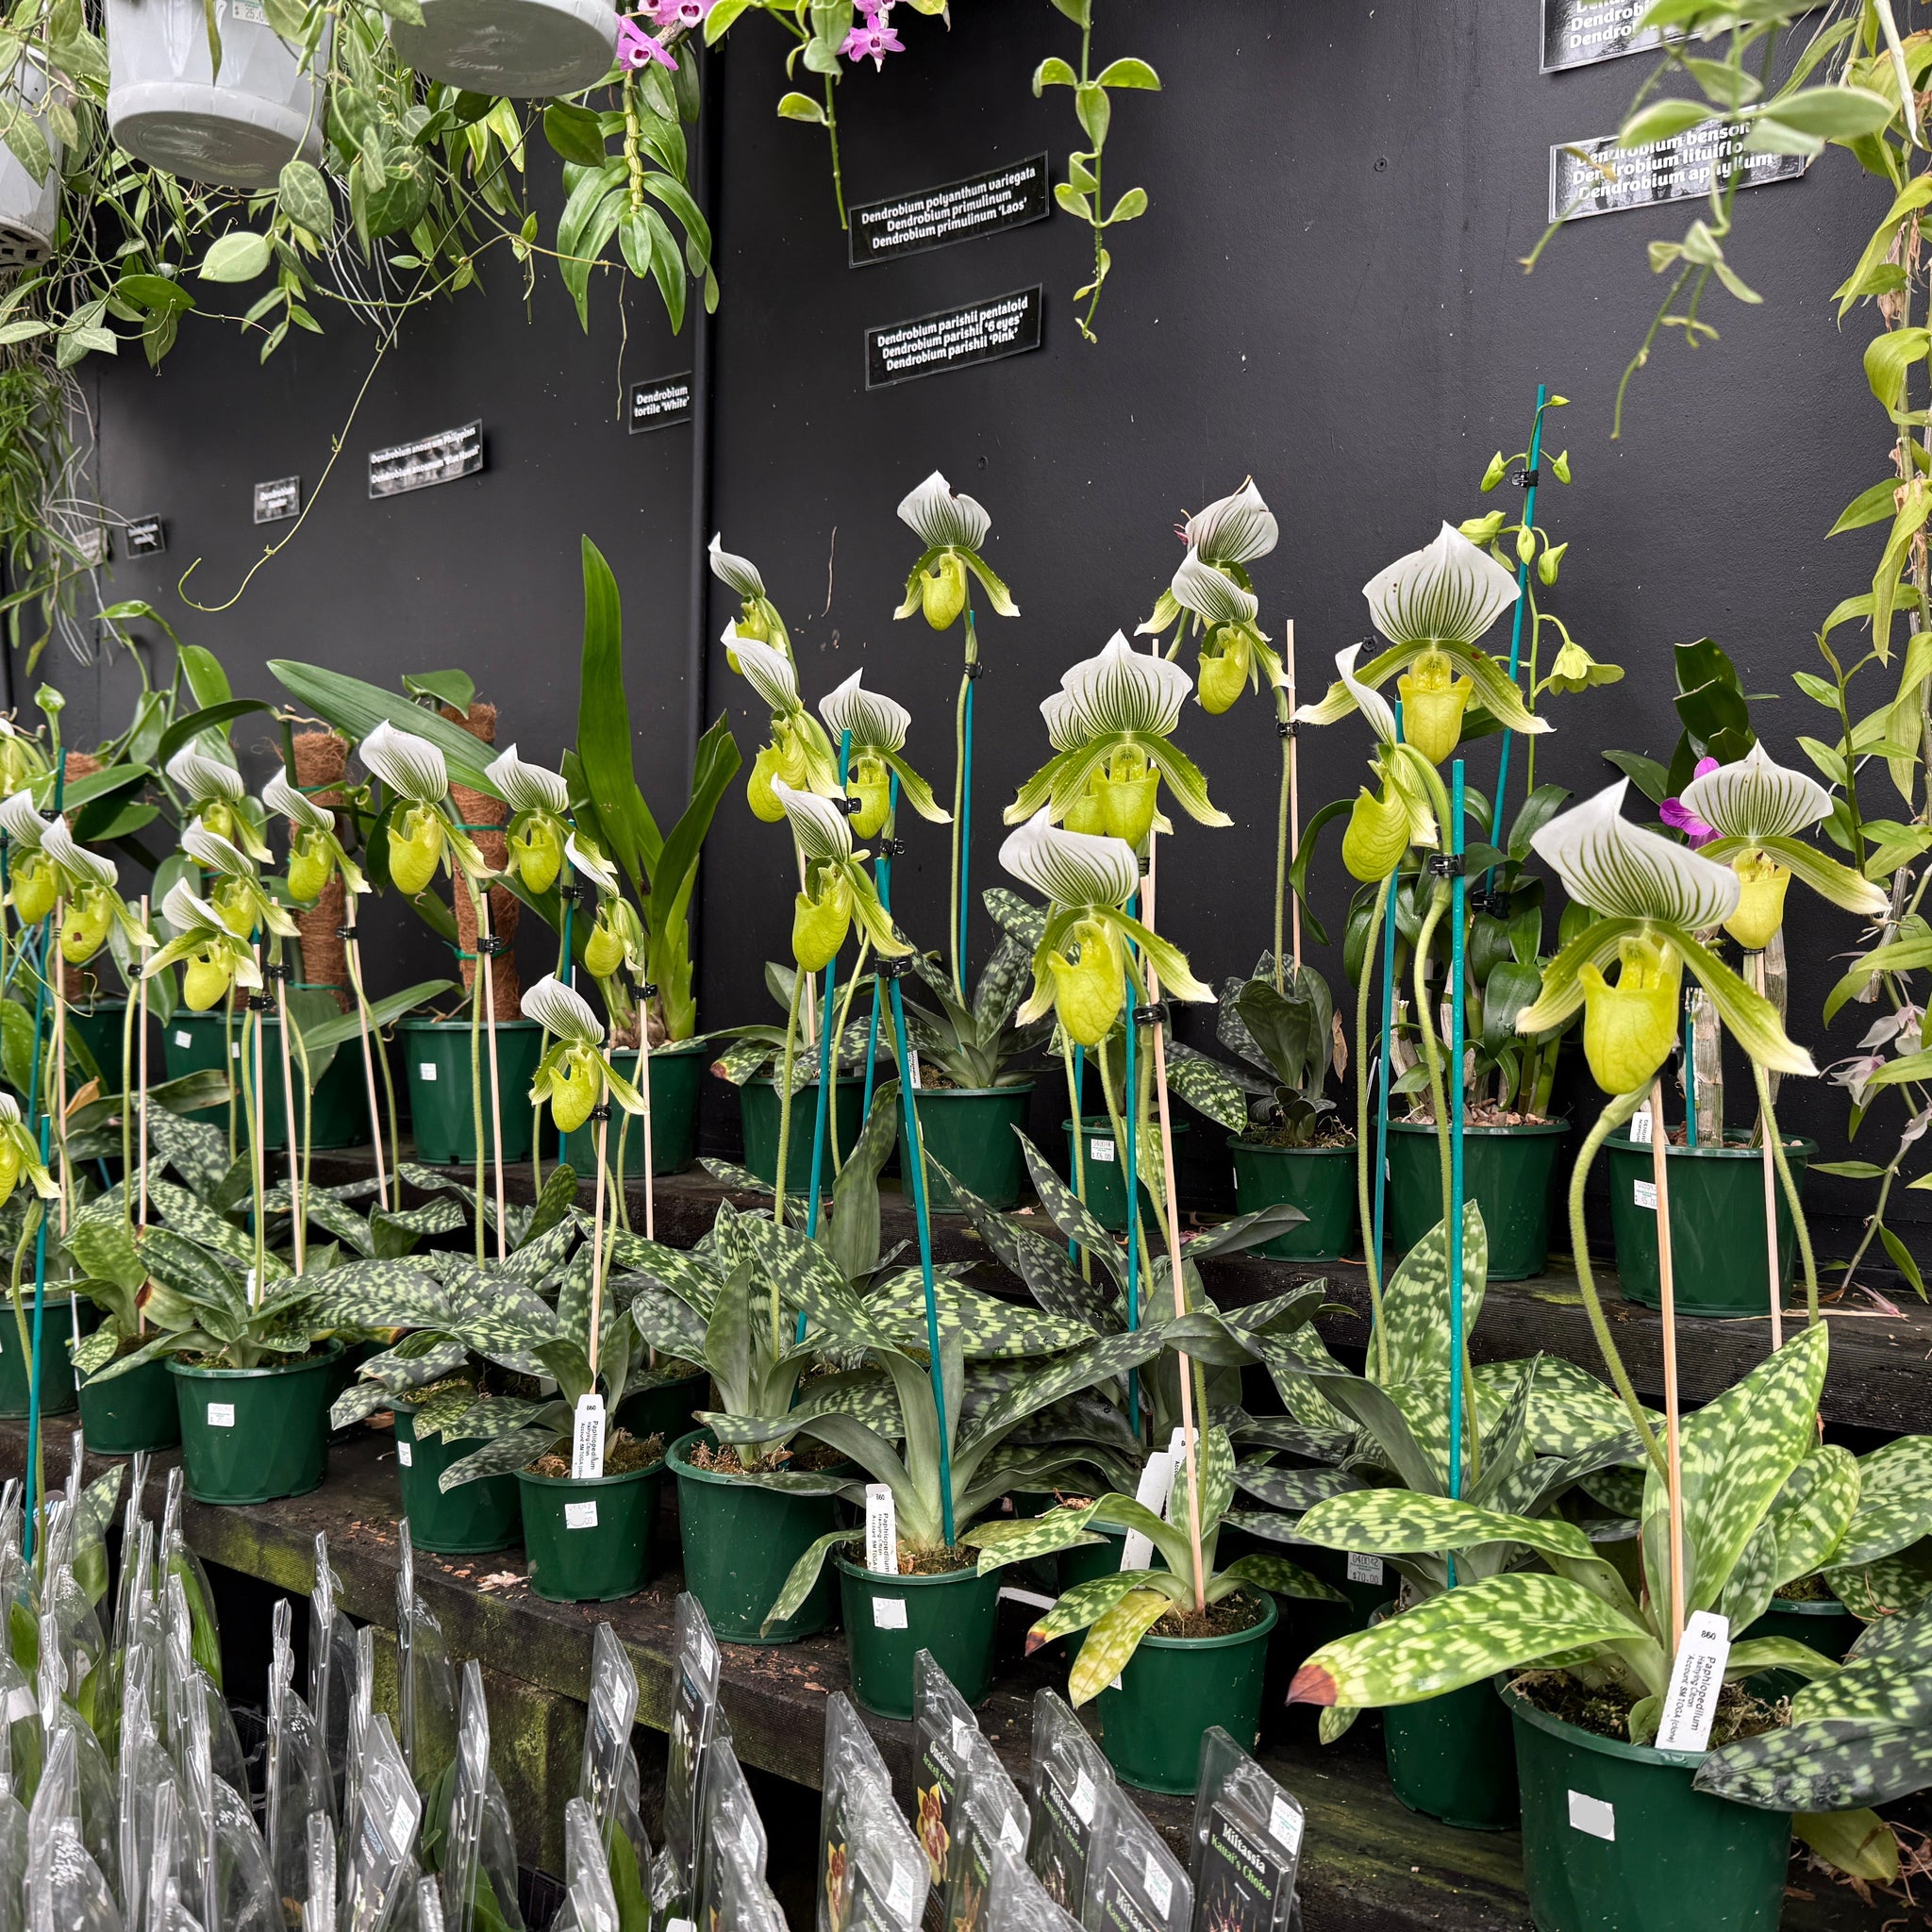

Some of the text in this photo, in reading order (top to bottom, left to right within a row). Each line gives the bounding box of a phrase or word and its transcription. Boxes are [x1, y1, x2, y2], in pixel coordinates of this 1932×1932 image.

[1571, 2, 1649, 32] Dendrob
[1686, 121, 1752, 145] benson
[1682, 140, 1744, 165] lituiflo
[861, 166, 1036, 225] Dendrobium polyanthum variegata
[1577, 168, 1685, 200] Dendrobium
[873, 225, 936, 249] Dendrobium
[937, 208, 997, 238] primulinum
[887, 190, 1011, 232] Dendrobium primulinum
[877, 295, 1028, 347] Dendrobium parishii pentaloid
[882, 335, 942, 359] Dendrobium
[942, 321, 984, 348] parishii
[886, 346, 947, 371] Dendrobium
[948, 333, 988, 359] parishii
[634, 404, 661, 418] tortile
[636, 386, 689, 406] Dendrobium
[371, 445, 411, 464] Dendrobium
[371, 467, 411, 484] Dendrobium
[1049, 1782, 1081, 1836] Miltassia
[1210, 1833, 1273, 1901] Kauai's Choice
[1222, 1822, 1266, 1874] Miltassia
